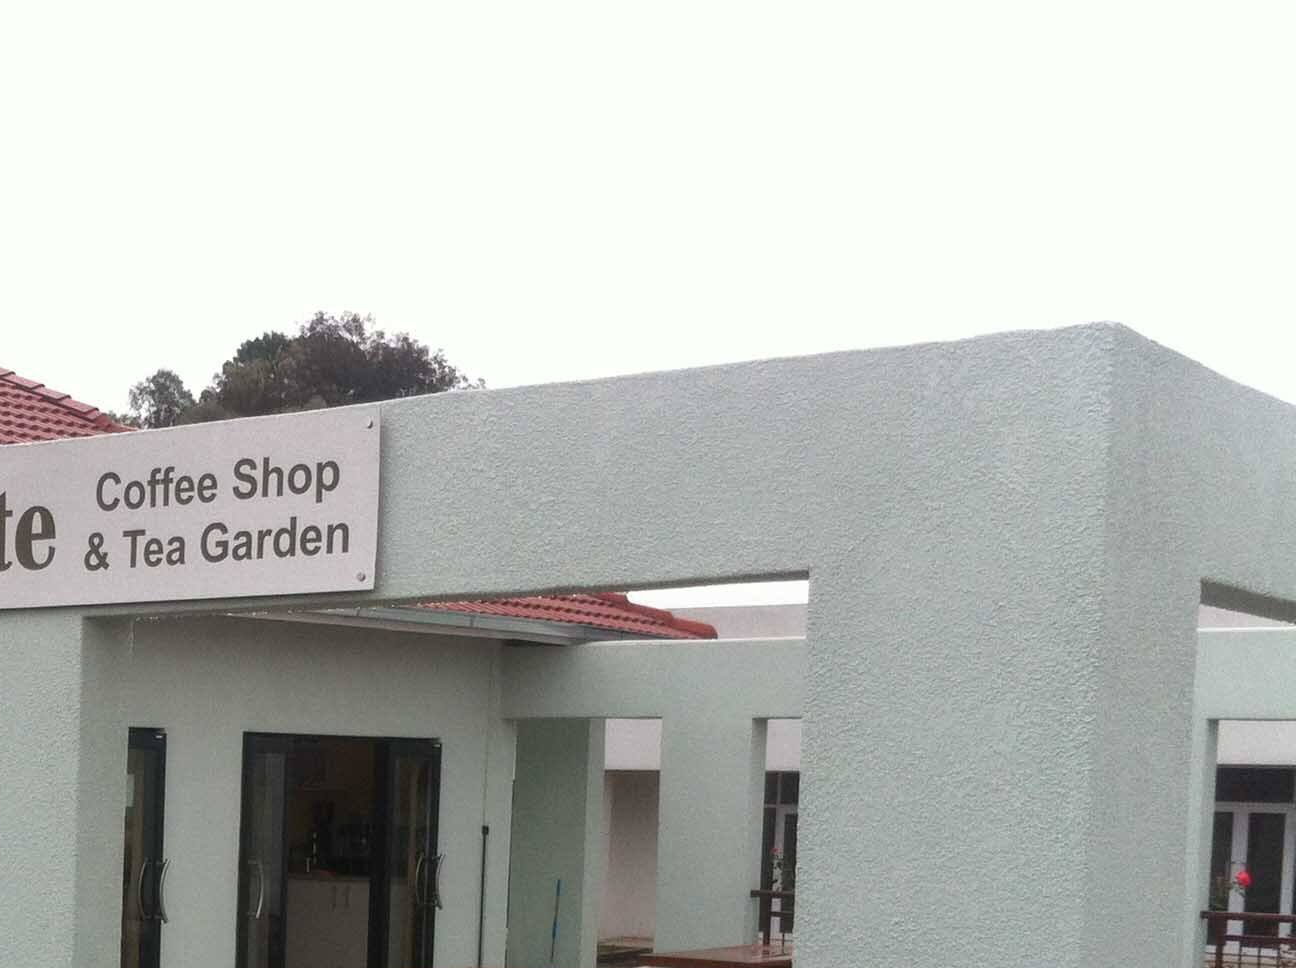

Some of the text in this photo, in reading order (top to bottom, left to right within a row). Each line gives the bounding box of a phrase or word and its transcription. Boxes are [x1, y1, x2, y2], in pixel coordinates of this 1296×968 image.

[96, 456, 340, 511] Coffee Shop
[84, 516, 350, 571] & Tea Garden
